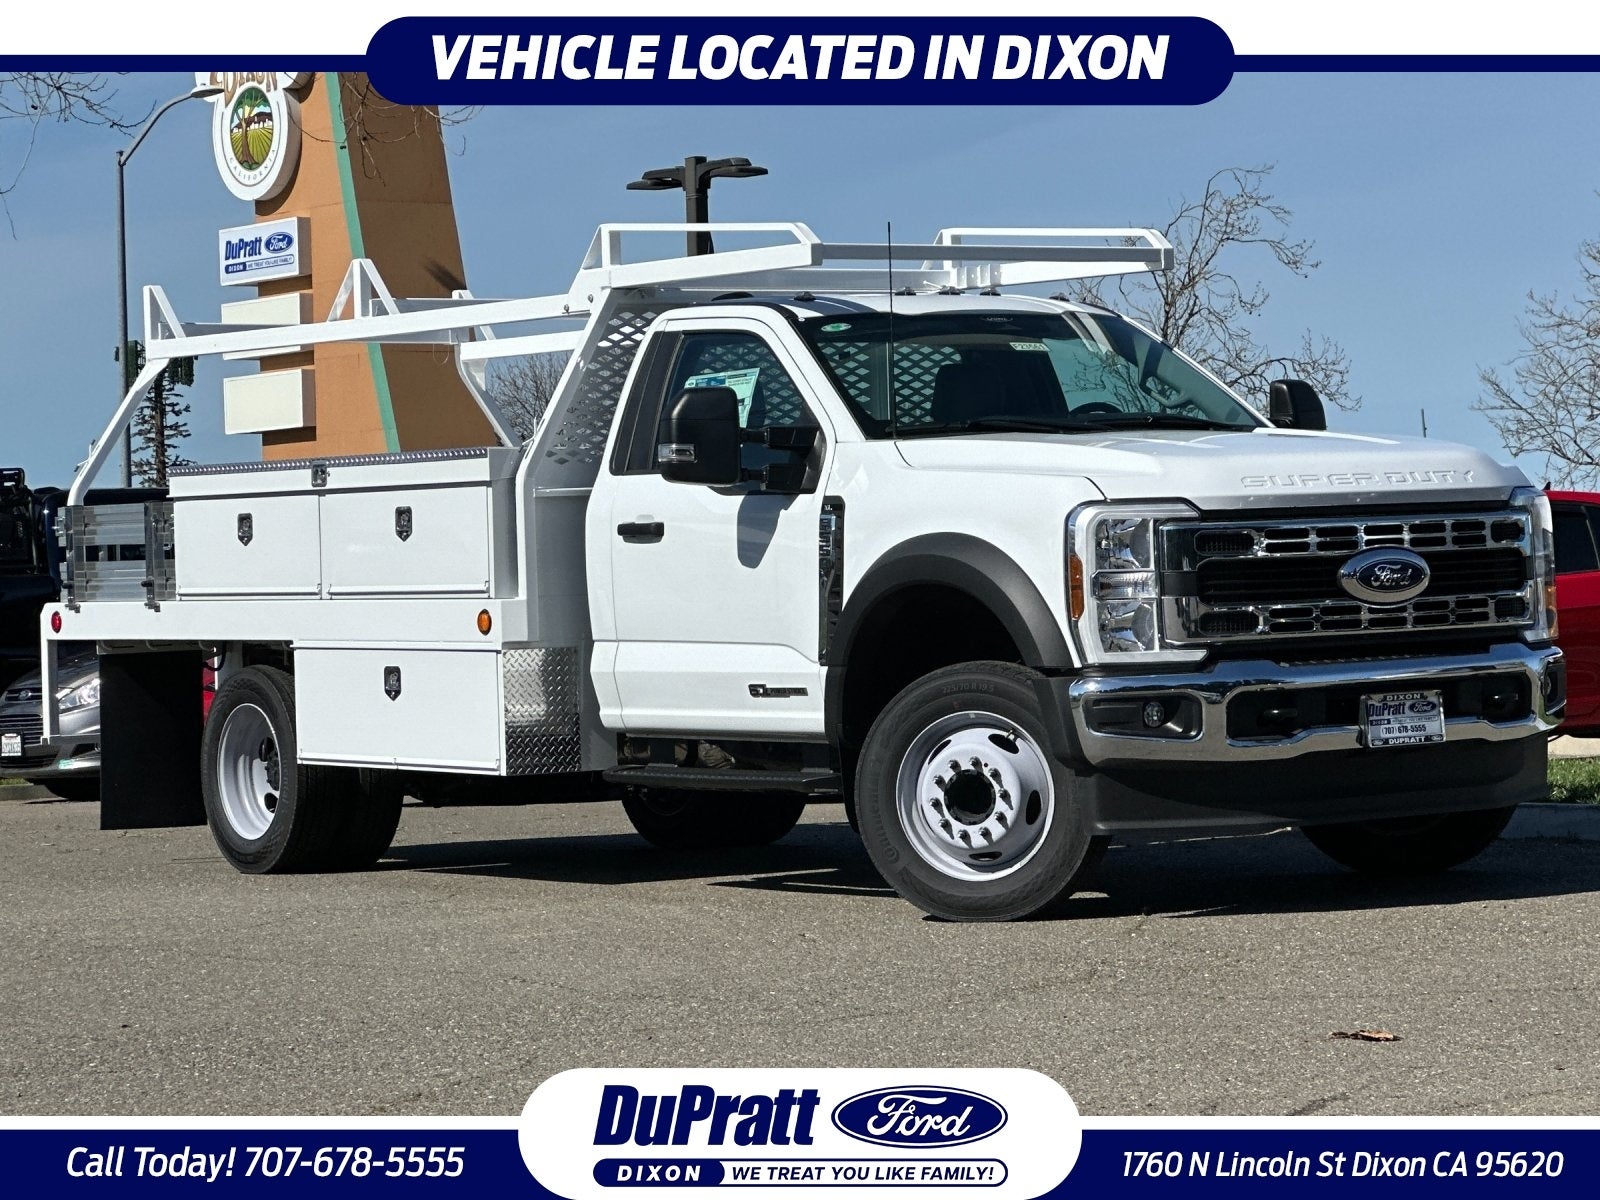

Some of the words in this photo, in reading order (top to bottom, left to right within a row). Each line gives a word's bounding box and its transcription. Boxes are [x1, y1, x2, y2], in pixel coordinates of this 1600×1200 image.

[225, 236, 263, 261] DuPratt
[269, 235, 289, 251] Ford
[228, 264, 244, 272] DIXON
[1241, 472, 1379, 489] SUPER
[1384, 470, 1474, 486] DUTY
[1371, 564, 1413, 587] Ford
[1386, 693, 1421, 701] DIXON
[1368, 702, 1406, 717] DuPratt
[1381, 726, 1397, 735] (707)
[1397, 724, 1427, 734] 678-5555
[1388, 736, 1426, 745] DUPRATT
